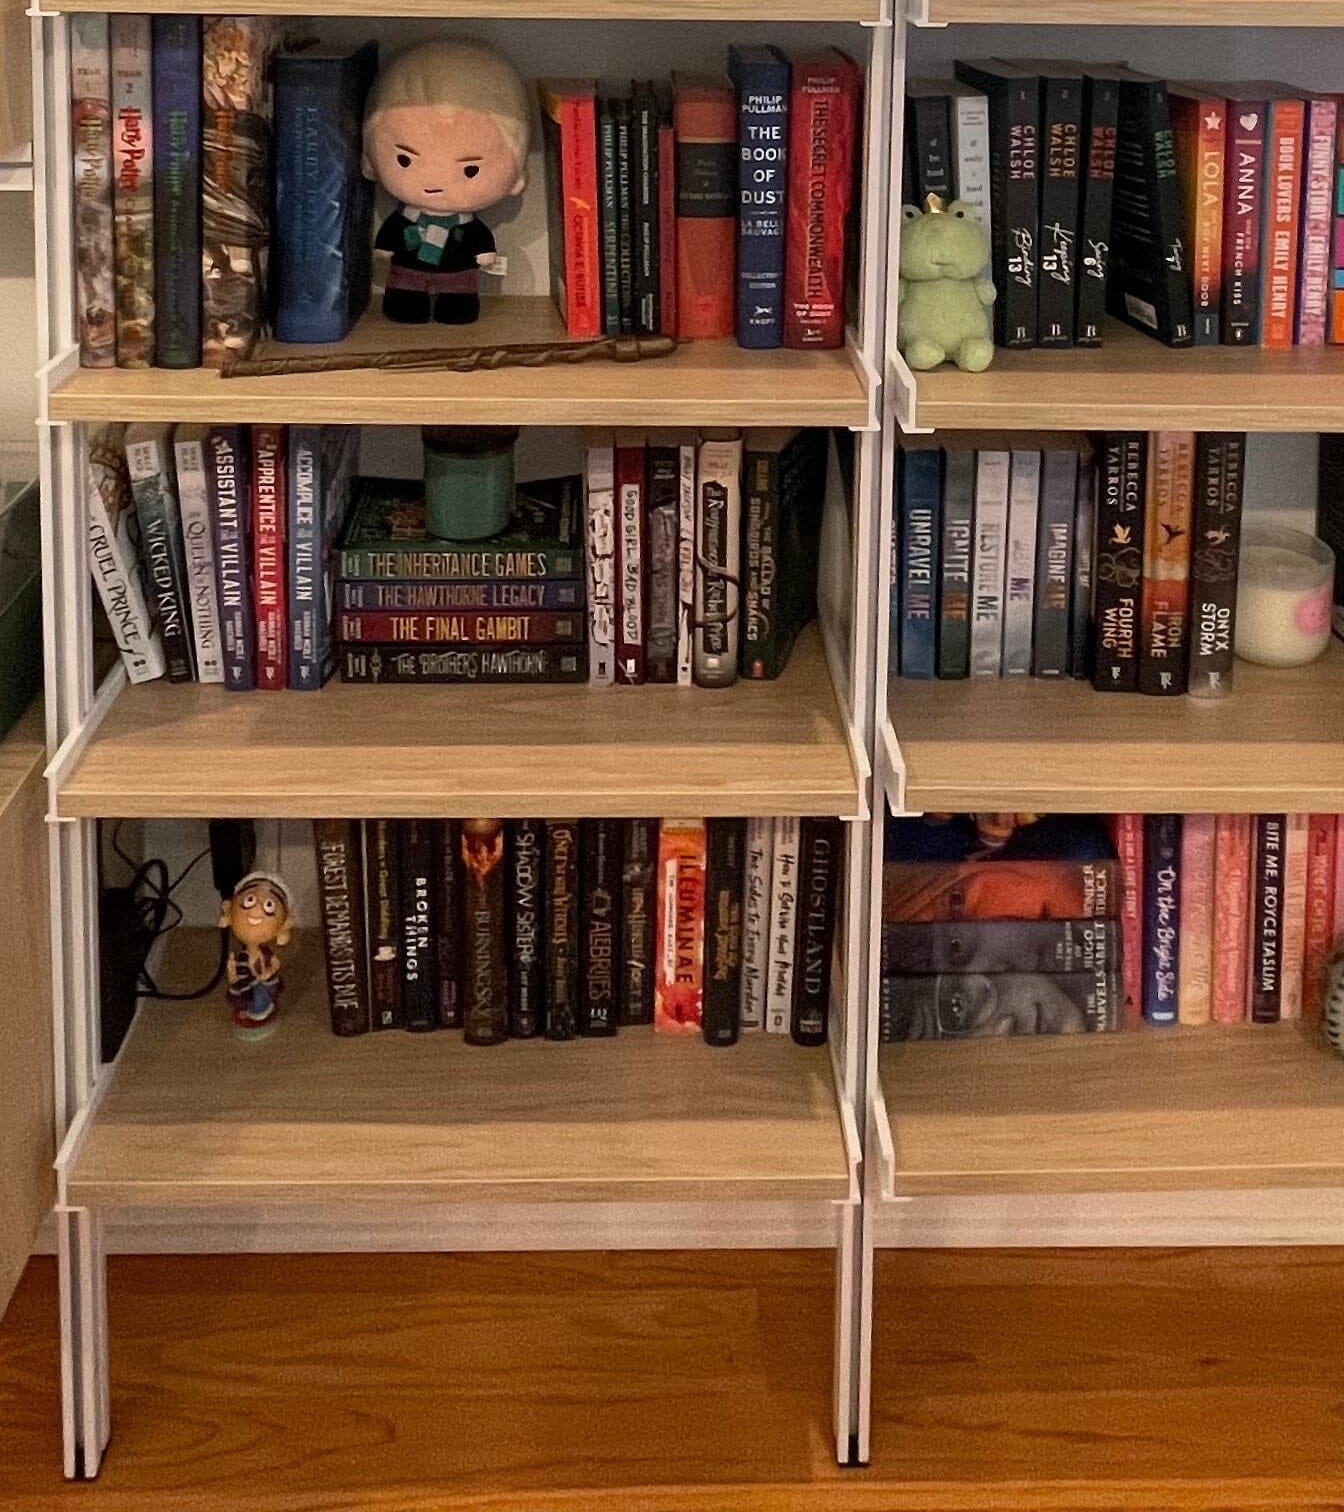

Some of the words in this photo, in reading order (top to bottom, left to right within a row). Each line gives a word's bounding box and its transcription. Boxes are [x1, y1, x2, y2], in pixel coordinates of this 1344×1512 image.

[748, 96, 783, 105] PHILIP
[813, 99, 829, 127] THE
[117, 106, 144, 148] Harry
[604, 125, 612, 160] PHILIP
[748, 126, 782, 140] THE
[118, 149, 145, 192] Potter
[810, 128, 828, 180] SECRET
[1009, 125, 1023, 180] WALSH
[1022, 125, 1036, 179] CHLOE
[1049, 123, 1063, 178] WALSH
[1063, 124, 1077, 178] CHLOE
[1278, 137, 1295, 172] BOOK
[1310, 136, 1330, 175] FUNNY
[605, 162, 613, 208] PULLMAN
[741, 190, 784, 204] DUST
[753, 169, 776, 182] OF
[1236, 152, 1255, 215] ANNA
[1275, 175, 1293, 223] LOVERS
[1308, 181, 1326, 221] STORY
[605, 221, 617, 299] SERPENTINE
[807, 181, 825, 299] COMMONWEALTH
[1041, 254, 1058, 271] 13
[1044, 223, 1075, 285] Keeping
[1233, 232, 1245, 277] FRENCH
[1273, 230, 1290, 271] EMILY
[1306, 235, 1324, 271] EMILY
[1008, 256, 1022, 273] 13
[1233, 282, 1242, 306] KISS
[1271, 275, 1288, 319] HENRY
[1304, 274, 1322, 315] HENRY
[215, 446, 238, 528] ASSISTANT
[257, 450, 277, 532] APPRENTICE
[296, 449, 314, 523] ACCOMPLICE
[1107, 446, 1121, 506] YARROS
[295, 542, 312, 601] VILLAIN
[368, 552, 395, 577] THE
[401, 553, 492, 577] INHERITANCE
[495, 552, 547, 577] GAMES
[908, 508, 932, 589] UNRAVEL
[979, 522, 1001, 592] RESTORE
[1046, 523, 1067, 582] IMAGINE
[88, 524, 117, 581] CRUEL
[108, 585, 140, 645] PRINCE
[145, 519, 169, 588] WICKED
[158, 591, 182, 637] KING
[221, 544, 241, 607] VILLAIN
[259, 547, 277, 605] VILLAIN
[377, 585, 405, 607] THE
[407, 585, 488, 607] HAWTHORNE
[493, 585, 546, 607] LEGACY
[1010, 578, 1030, 601] ME
[390, 617, 418, 640] THE
[426, 616, 468, 641] FINAL
[476, 616, 530, 641] GAMBIT
[909, 593, 930, 620] ME
[977, 595, 998, 622] ME
[1102, 607, 1118, 649] WING
[1117, 598, 1134, 658] FOURTH
[1150, 601, 1166, 658] FLAME
[1168, 611, 1183, 648] IRON
[1199, 602, 1215, 656] STORM
[1215, 607, 1230, 651] ONYX
[1265, 822, 1278, 850] BITE
[516, 832, 536, 908] SHADOW
[1157, 865, 1174, 893] On
[416, 878, 428, 948] BROKEN
[677, 855, 697, 984] ILLUMINAE
[804, 839, 830, 994] GHOSTLAND
[1262, 886, 1277, 937] ROYCE
[406, 916, 418, 981] THINGS
[1083, 930, 1093, 968] HUGO
[1156, 927, 1174, 969] Bright
[1261, 941, 1276, 991] TASLIM
